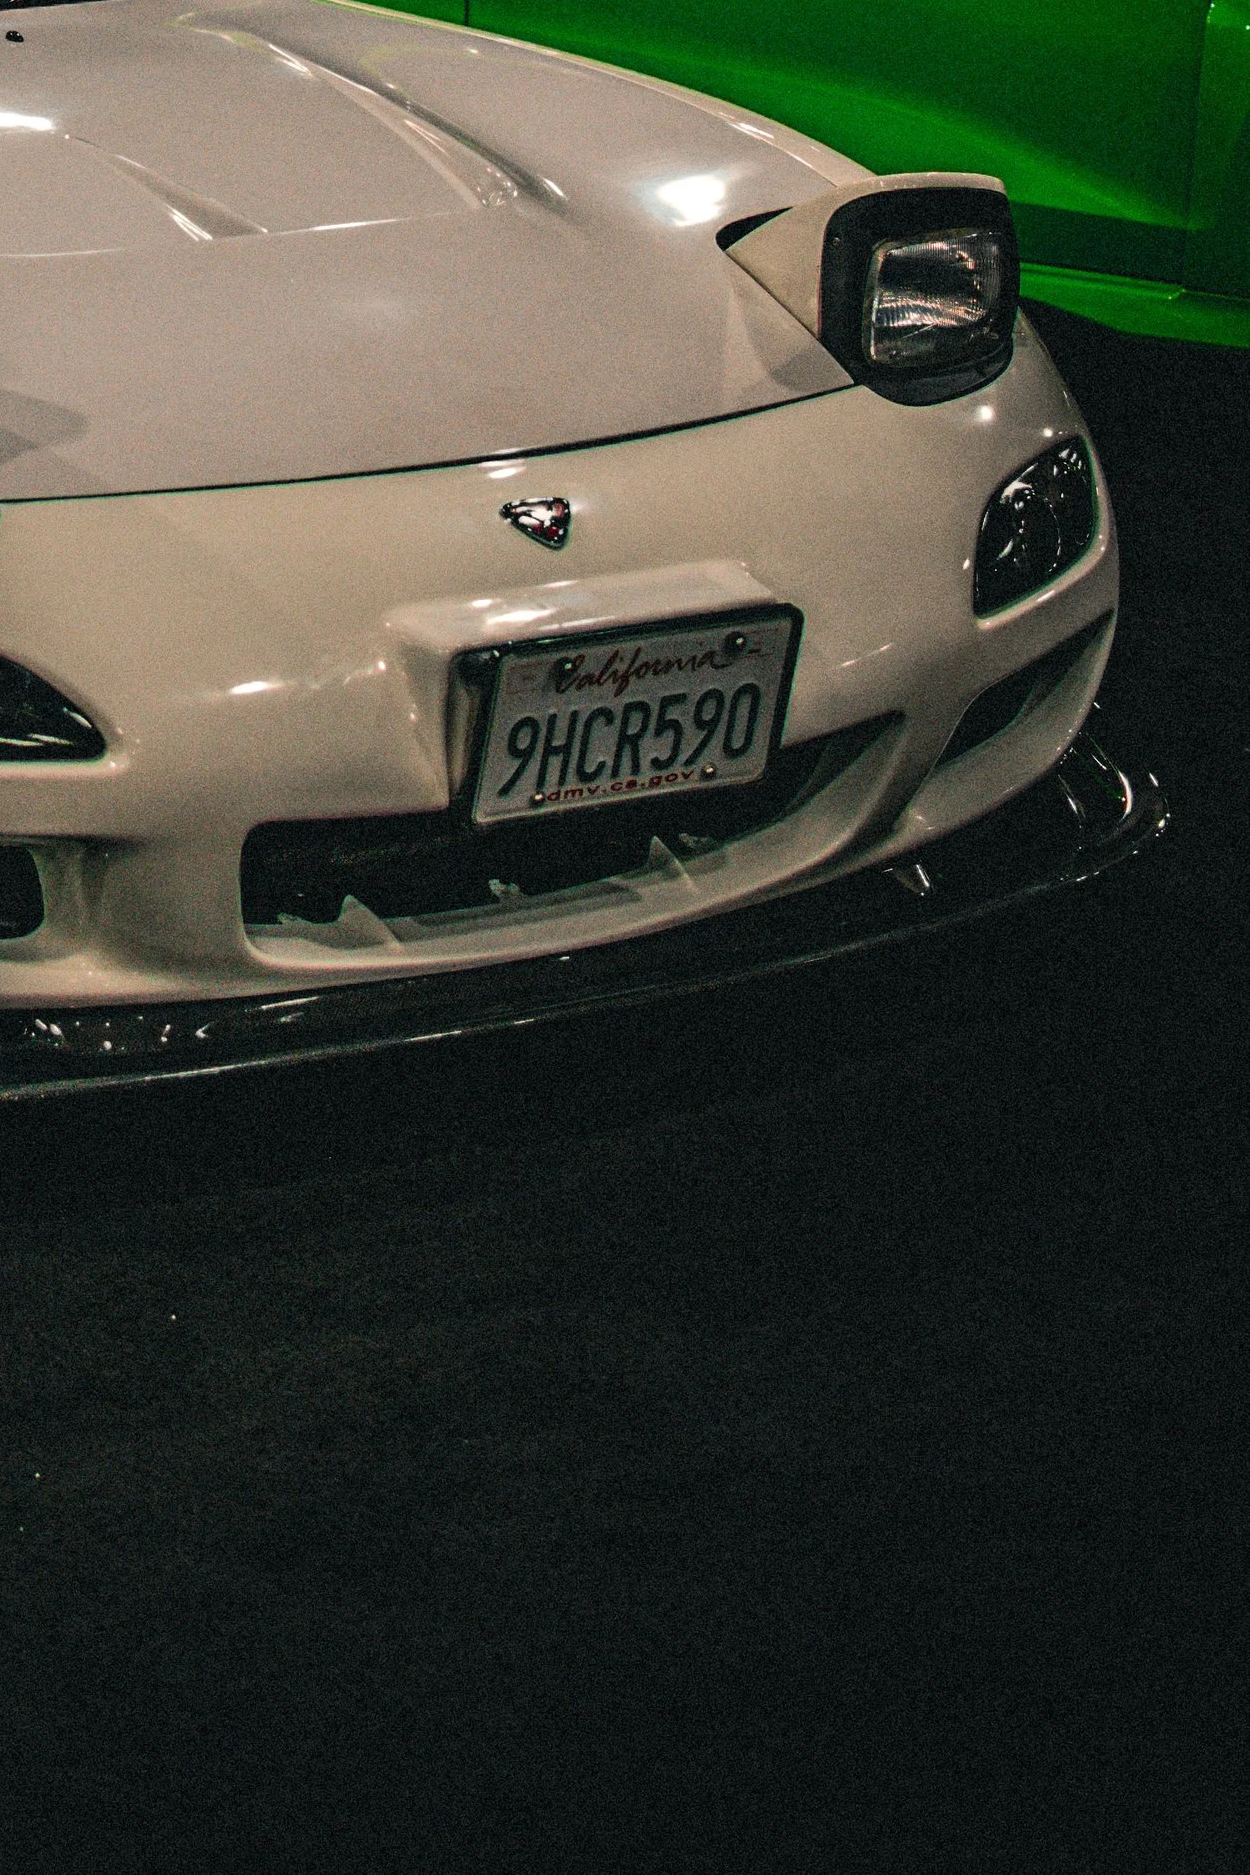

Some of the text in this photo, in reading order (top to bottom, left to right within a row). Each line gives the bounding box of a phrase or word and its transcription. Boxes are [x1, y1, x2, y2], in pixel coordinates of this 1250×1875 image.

[554, 646, 733, 698] California
[498, 681, 762, 799] 9HCR590
[546, 768, 696, 802] dmv.ca.gov
